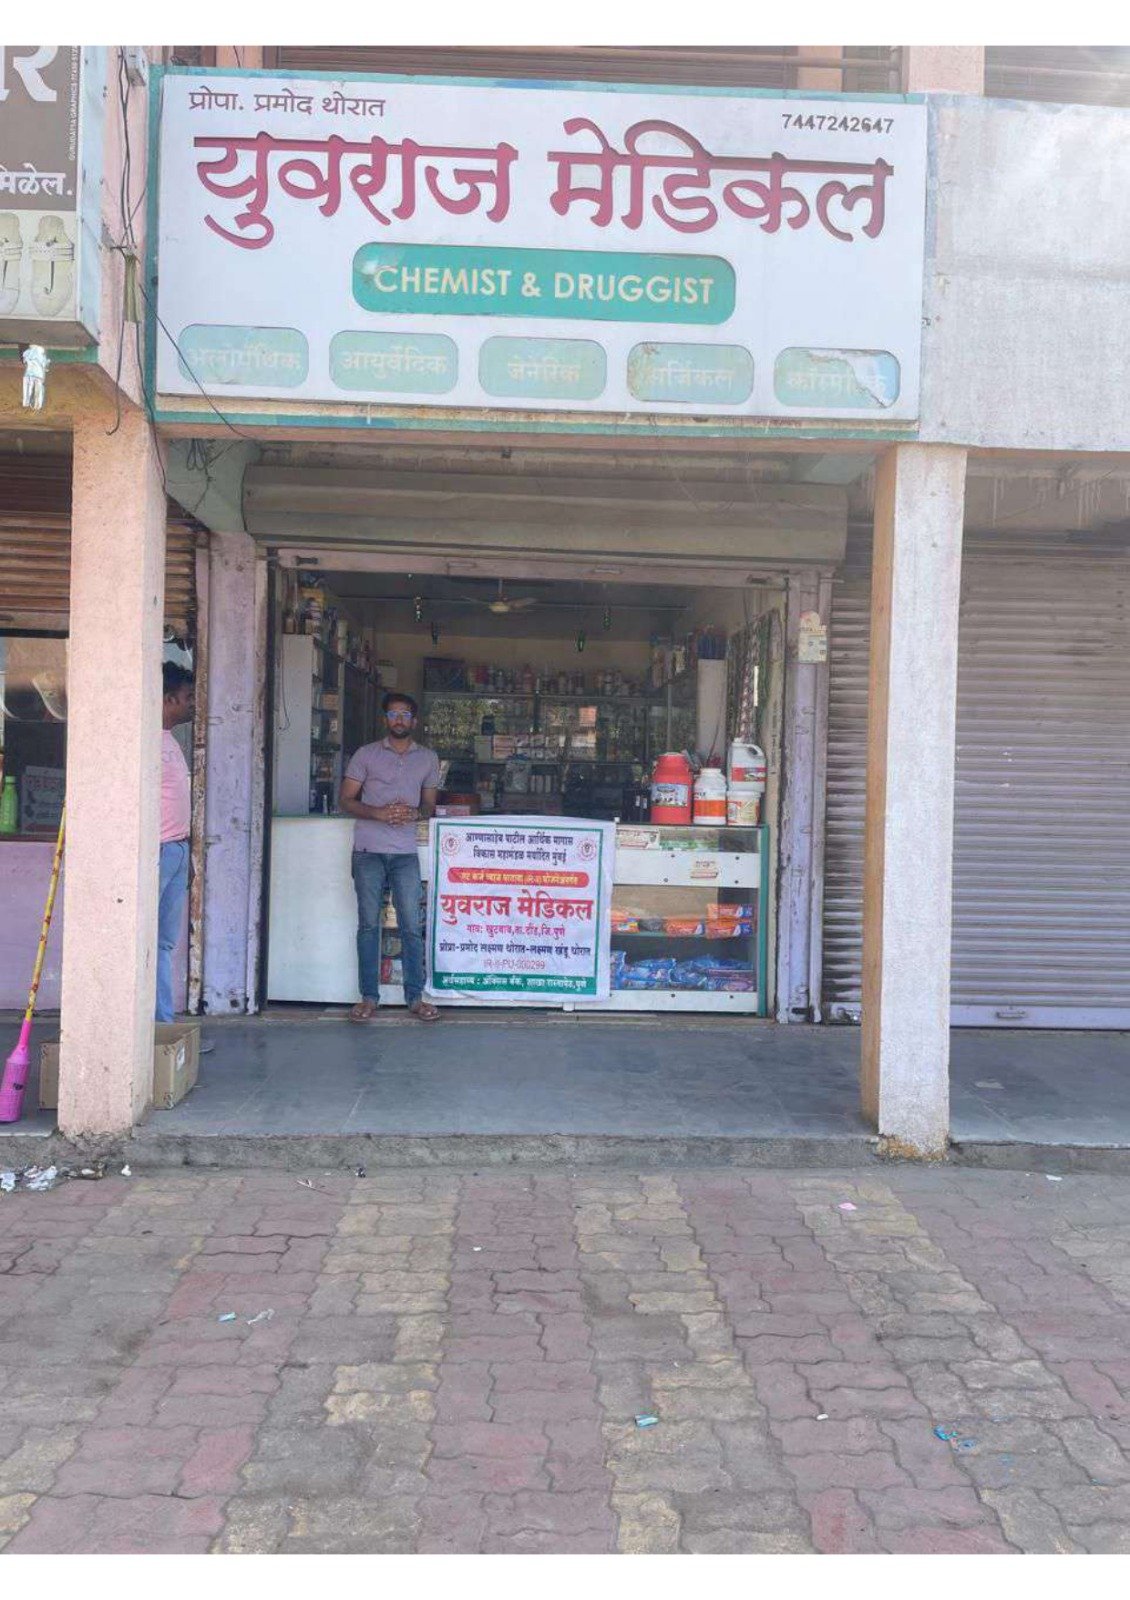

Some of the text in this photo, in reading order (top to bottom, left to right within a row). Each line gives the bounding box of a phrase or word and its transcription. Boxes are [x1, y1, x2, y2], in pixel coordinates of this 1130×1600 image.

[188, 85, 386, 117] प्रोपा. प्रमोद थोरात
[781, 113, 894, 135] 7447242647
[193, 117, 894, 249] युवराज मेडिकल
[374, 264, 715, 304] CHEMIST & DRUGGIST
[473, 845, 496, 859] विकास
[440, 889, 593, 925] युवराज मेडिकल
